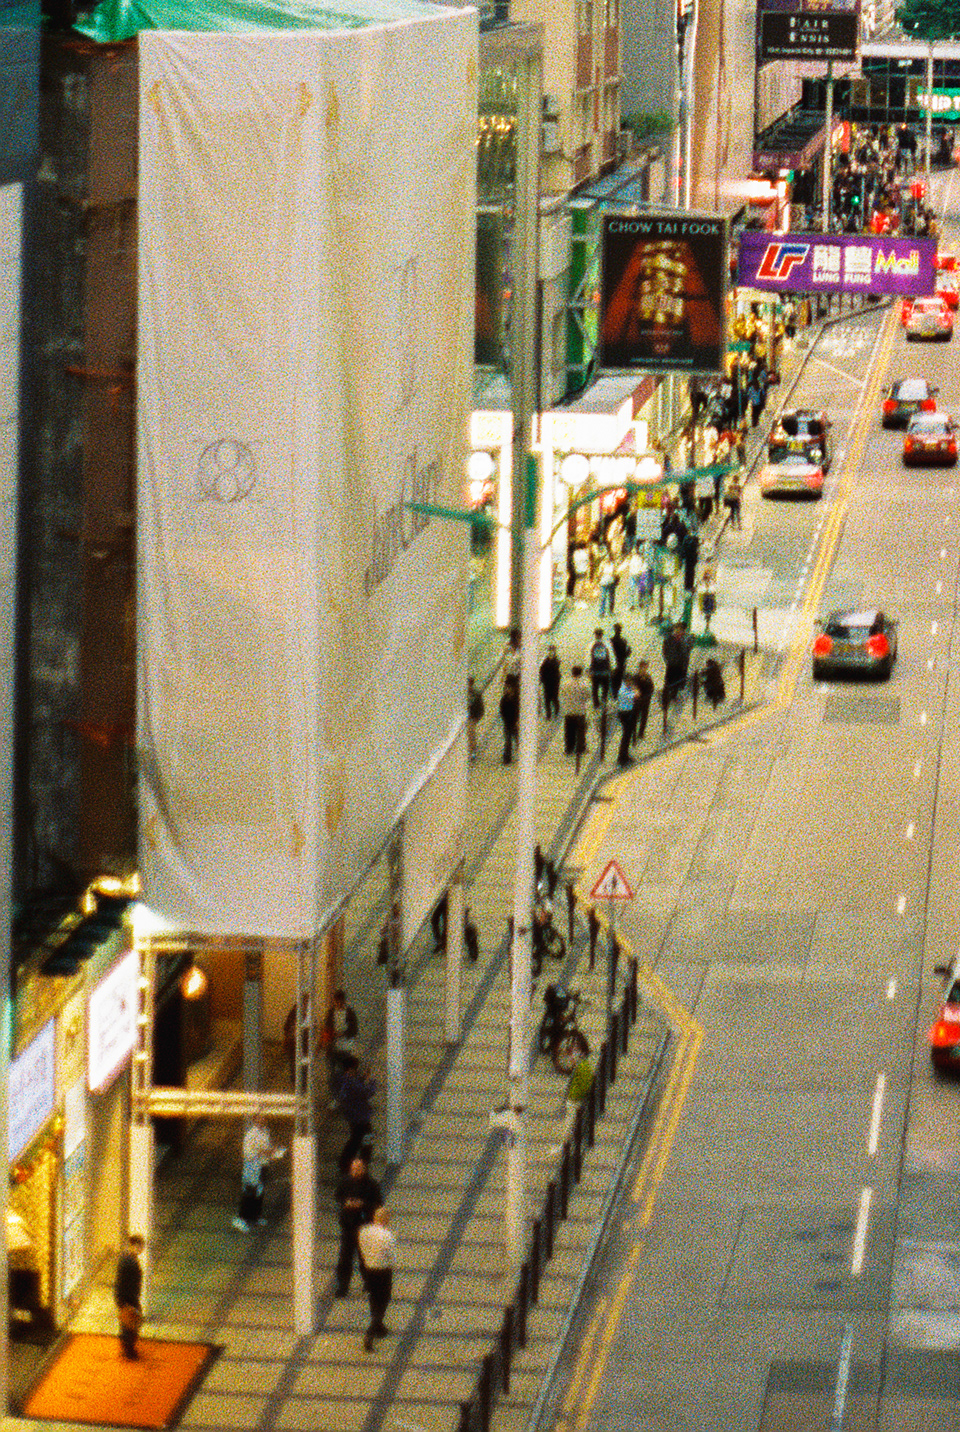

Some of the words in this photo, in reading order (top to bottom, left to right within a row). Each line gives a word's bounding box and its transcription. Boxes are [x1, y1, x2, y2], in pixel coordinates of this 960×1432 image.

[608, 220, 653, 234] CHOW
[656, 221, 678, 235] TAI
[681, 222, 719, 236] FOOK
[874, 248, 920, 275] Mall
